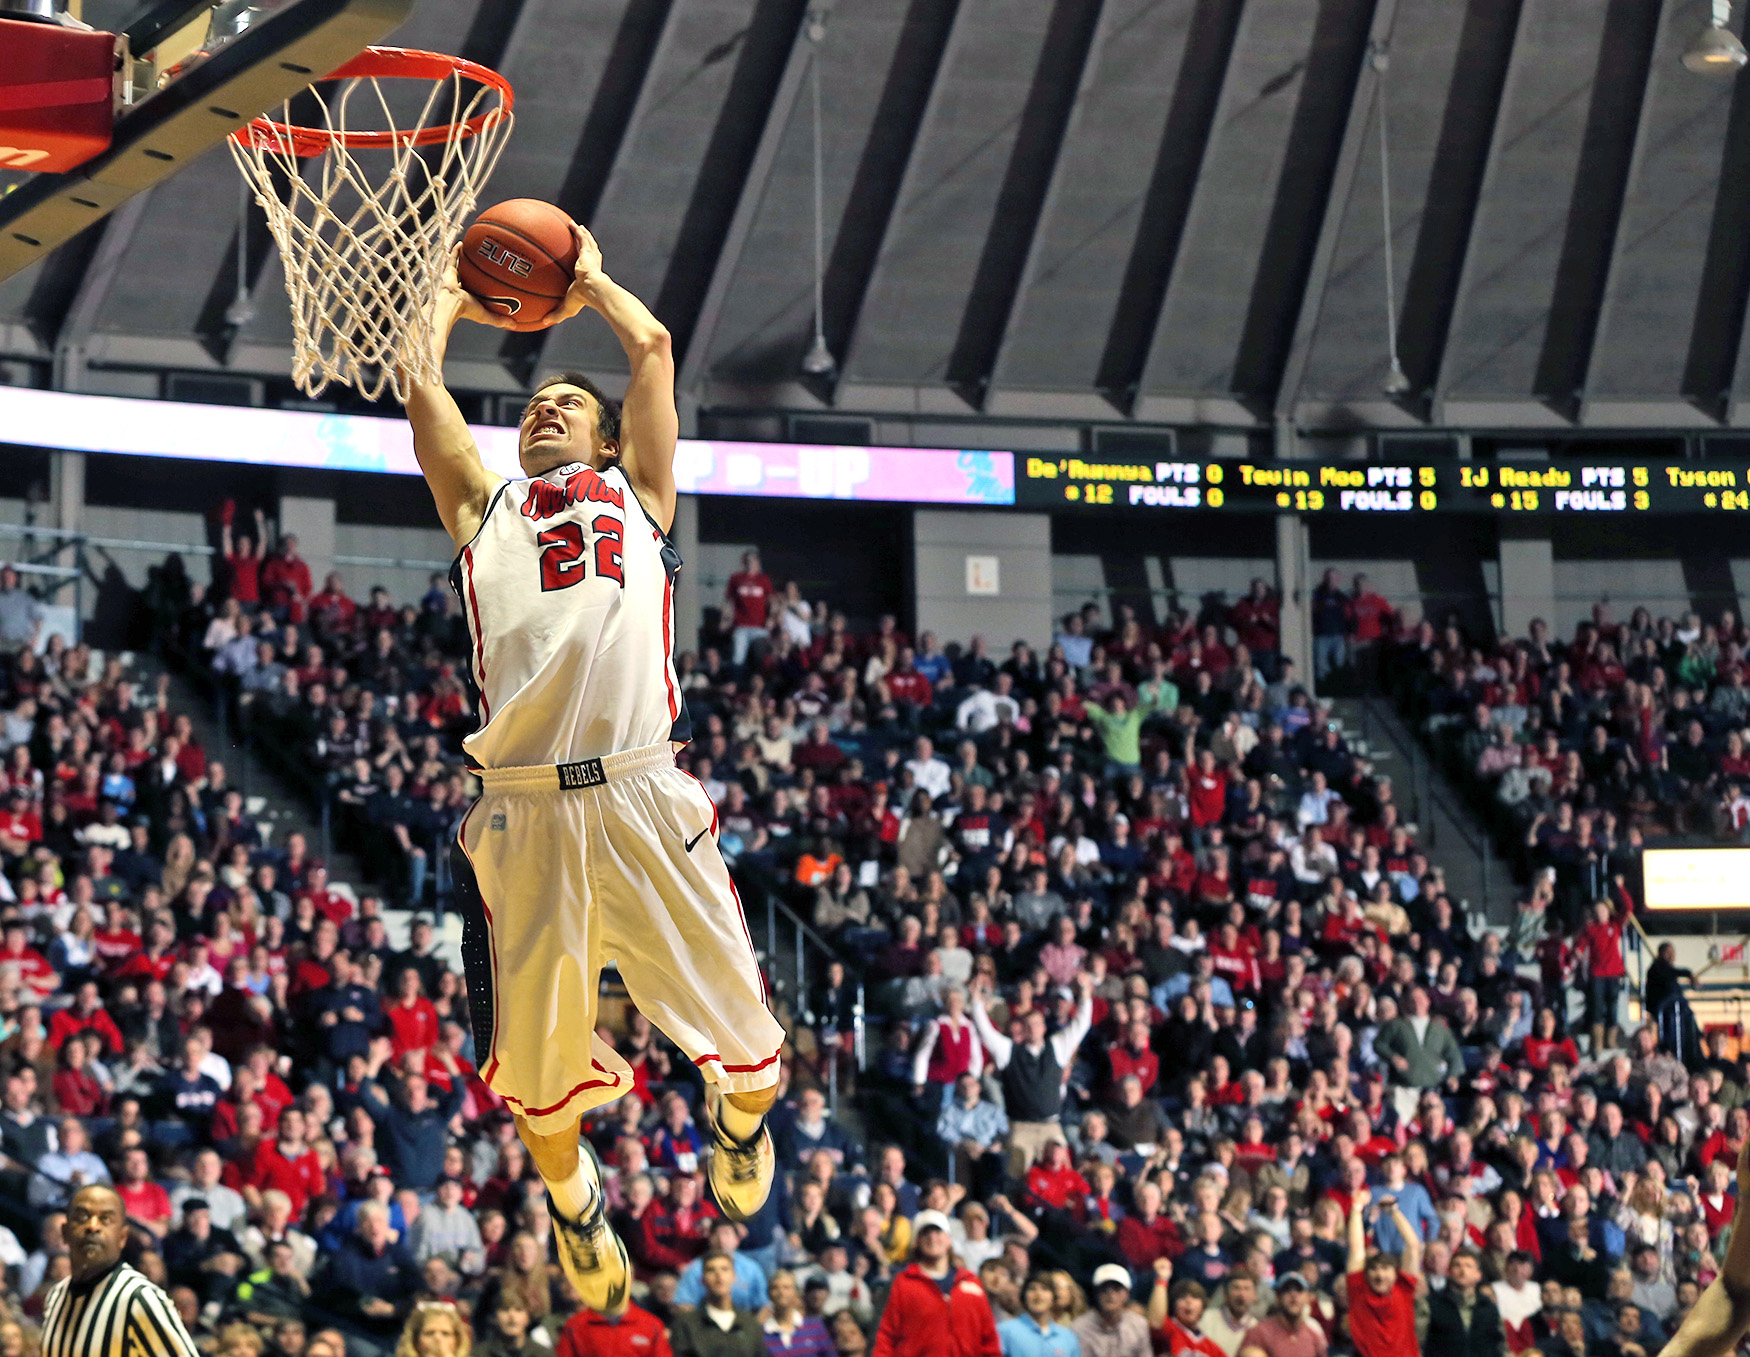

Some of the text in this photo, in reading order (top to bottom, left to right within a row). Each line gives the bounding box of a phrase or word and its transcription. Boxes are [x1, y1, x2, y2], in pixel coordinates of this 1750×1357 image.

[478, 238, 533, 278] ELITE
[1155, 462, 1200, 483] PTS
[1206, 463, 1223, 484] 0
[1320, 467, 1366, 486] Moo
[1368, 466, 1412, 488] PTS
[1418, 466, 1436, 487] 5
[1460, 466, 1649, 487] IJ Ready PTS 5
[1665, 466, 1736, 487] Tyson
[520, 469, 625, 521] Ole Mis
[1129, 485, 1201, 507] FOULS
[1206, 487, 1224, 508] 0
[1340, 490, 1413, 511] FOULS
[1419, 490, 1437, 511] 0
[1555, 490, 1627, 511] FOULS
[1634, 490, 1650, 511] 3
[537, 514, 625, 593] 22
[562, 762, 601, 786] REBELS
